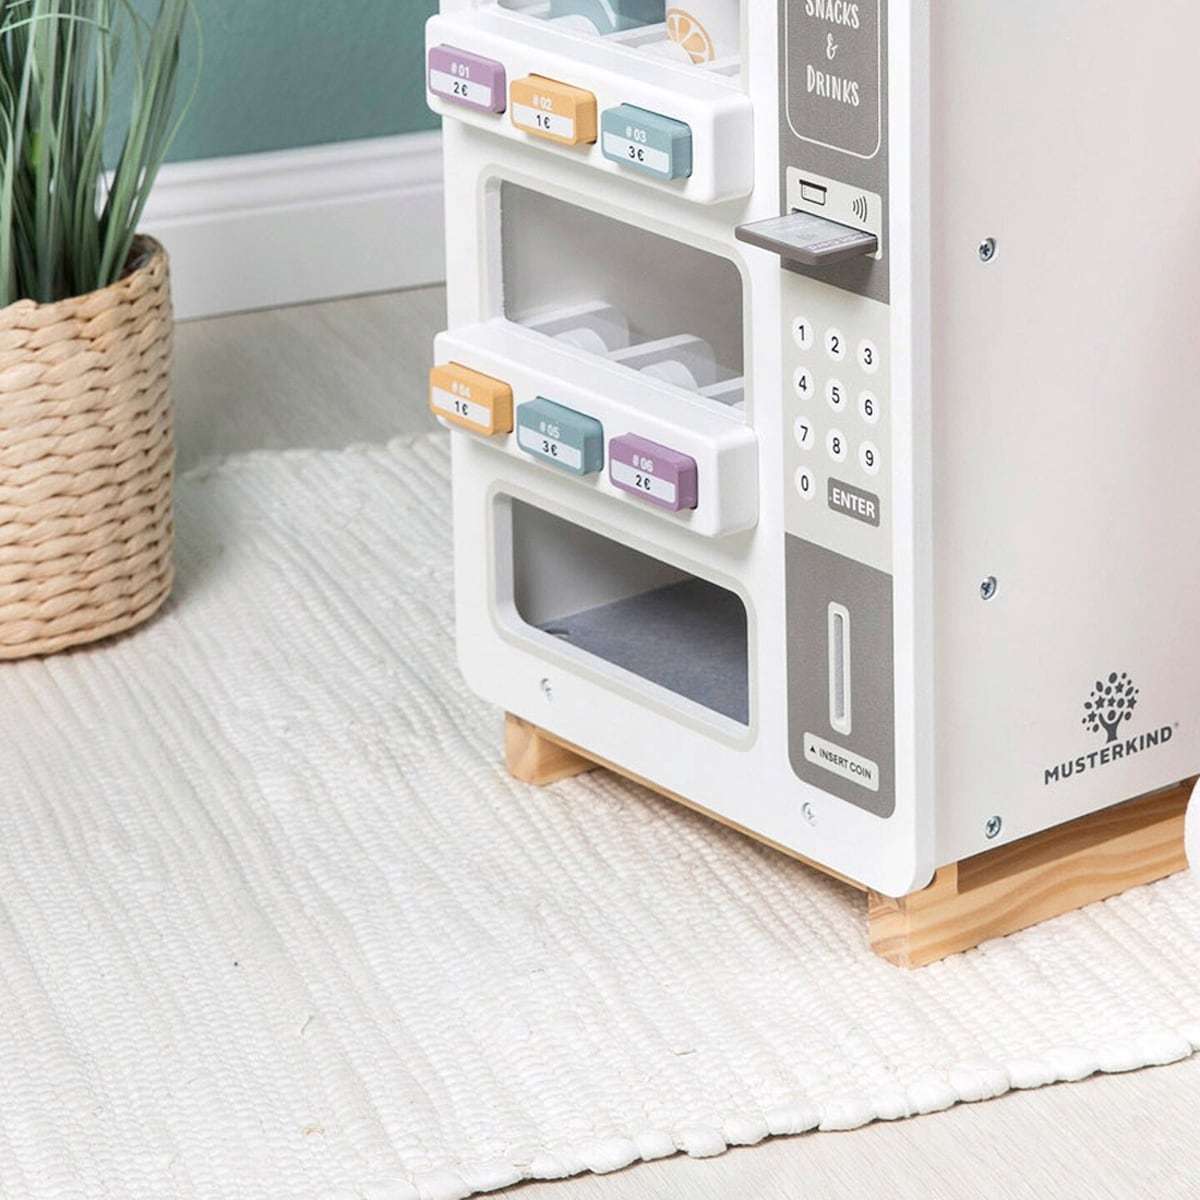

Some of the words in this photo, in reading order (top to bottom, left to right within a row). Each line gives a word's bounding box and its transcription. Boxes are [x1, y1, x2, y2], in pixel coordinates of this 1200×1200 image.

[826, 33, 839, 60] &
[806, 64, 860, 107] DRINKS
[798, 324, 805, 341] 1
[831, 336, 839, 354] 2
[864, 347, 873, 365] 3
[798, 375, 807, 392] 4
[831, 386, 840, 404] 5
[864, 399, 873, 416] 6
[800, 424, 808, 441] 7
[832, 437, 841, 454] 8
[865, 449, 874, 467] 9
[801, 474, 809, 491] 0
[832, 488, 876, 519] ENTER
[819, 748, 848, 769] INSERT
[849, 761, 872, 779] COIN
[1044, 725, 1172, 785] MUSTERKIND
